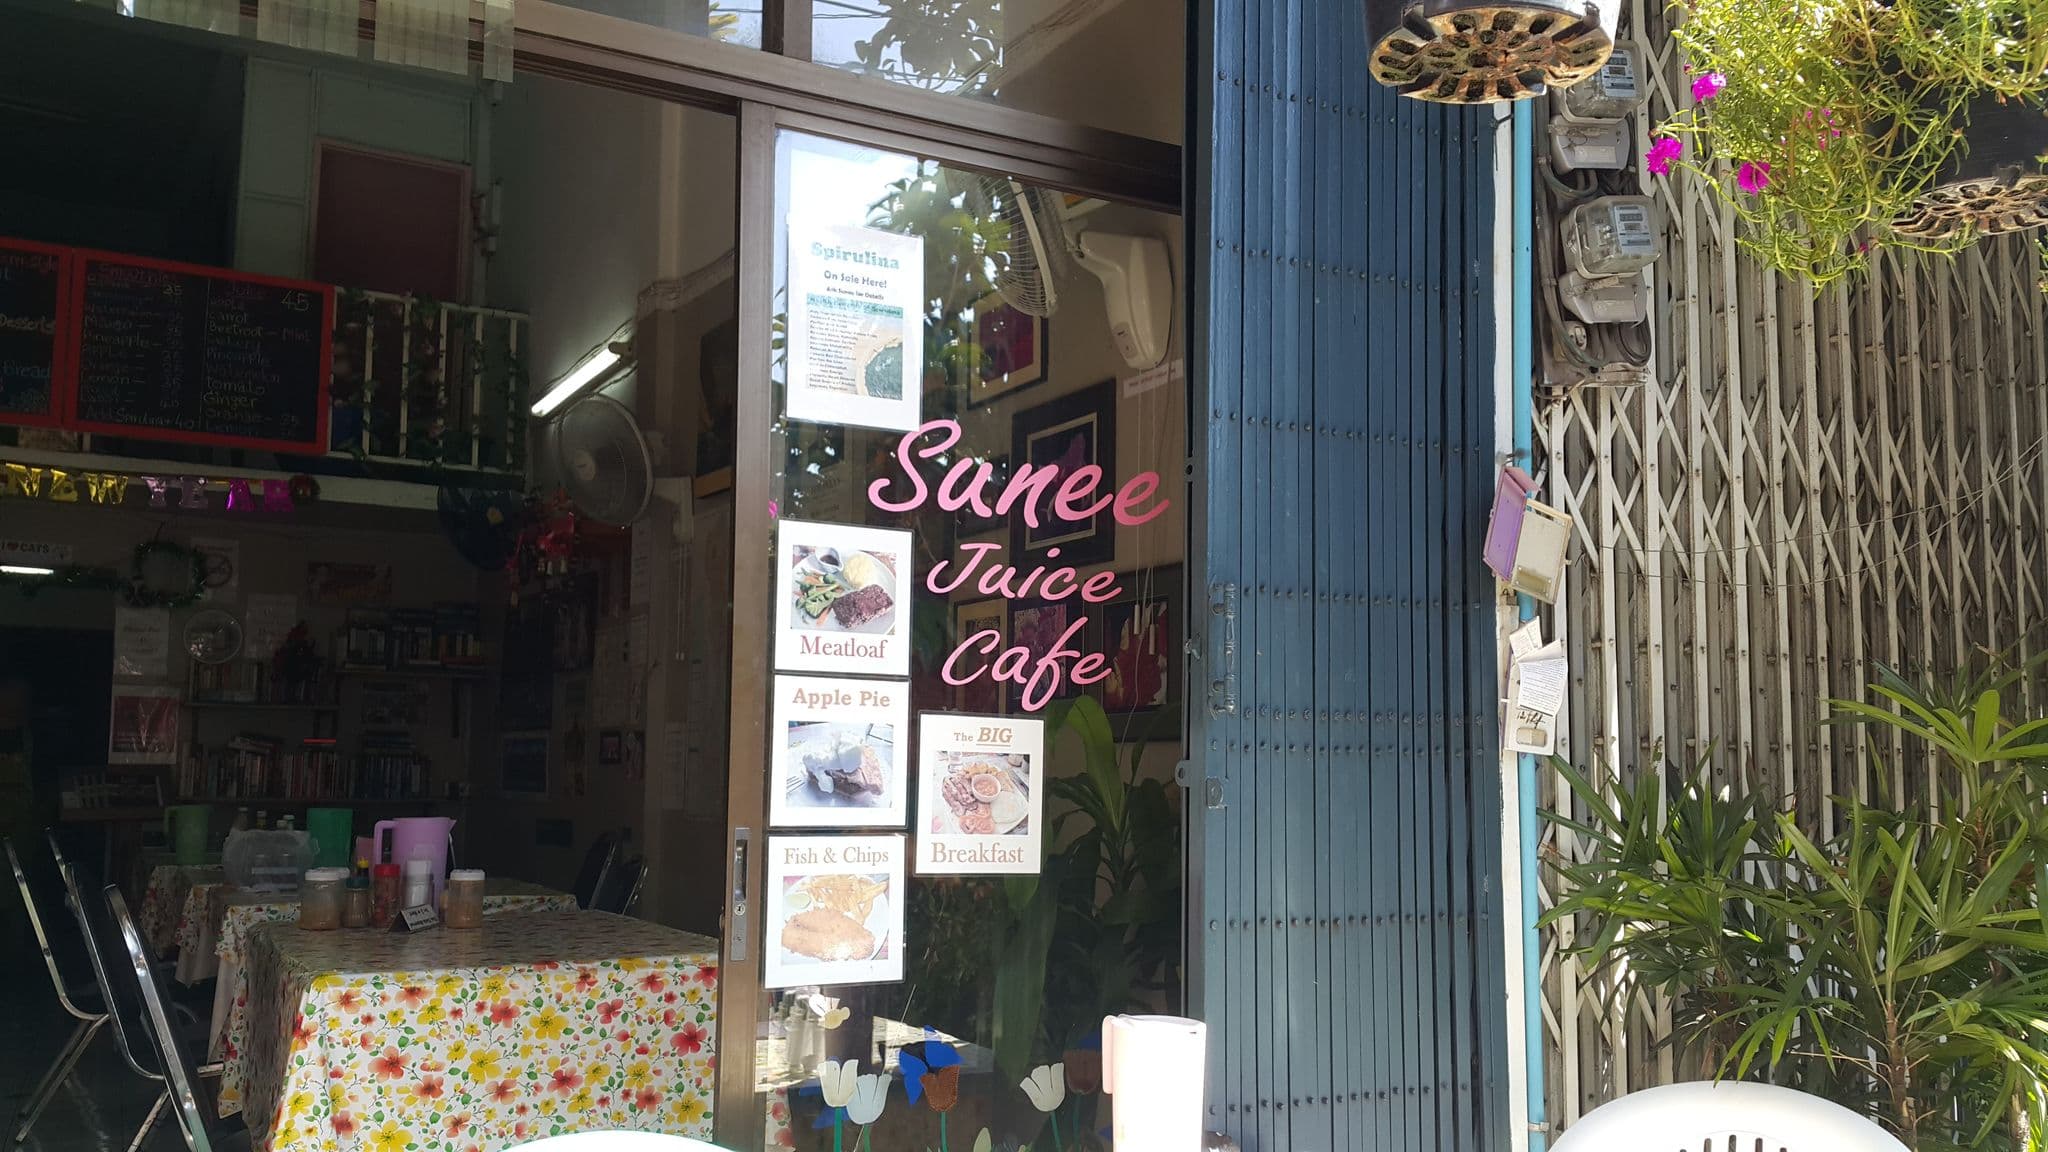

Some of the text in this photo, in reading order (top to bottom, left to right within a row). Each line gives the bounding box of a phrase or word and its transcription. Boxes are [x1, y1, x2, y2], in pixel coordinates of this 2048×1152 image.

[811, 242, 900, 269] Spirulina
[824, 270, 888, 289] On Sale Here!
[280, 289, 312, 313] 45
[6, 462, 128, 505] NEW
[868, 419, 1170, 528] Sunee
[20, 543, 49, 553] CATS
[926, 543, 1122, 603] Juice
[800, 635, 889, 659] Meatloaf
[941, 617, 1112, 712] Cafe
[792, 687, 891, 709] Apple Pie
[954, 726, 1013, 746] The BIG
[784, 845, 889, 867] Fish & Chips
[931, 841, 1024, 864] Breakfast
